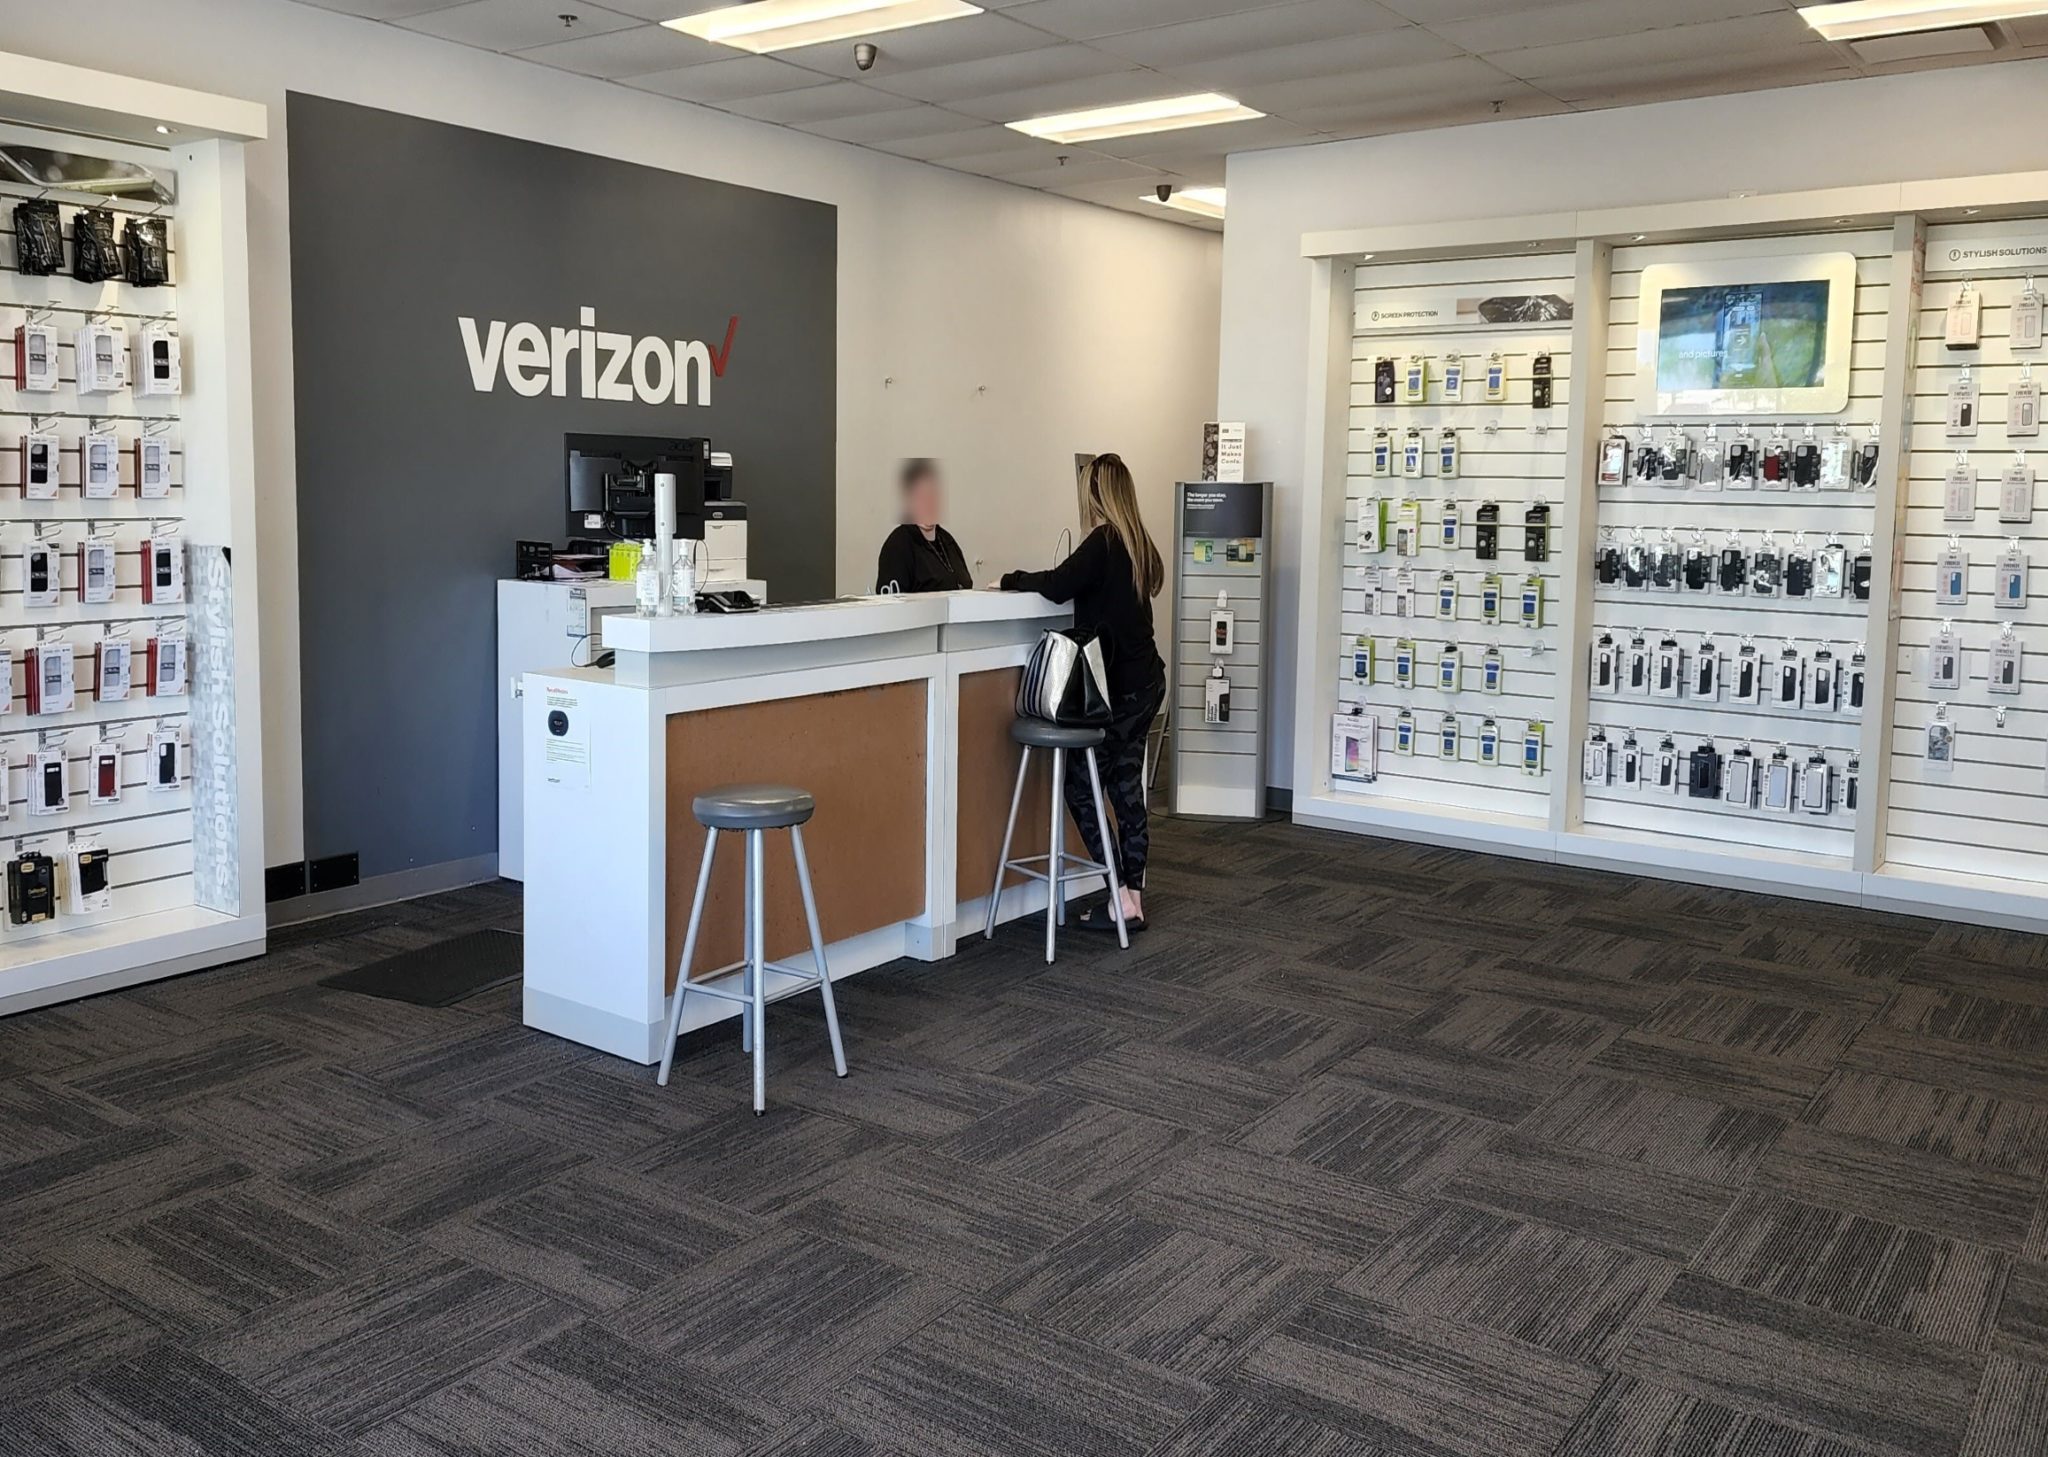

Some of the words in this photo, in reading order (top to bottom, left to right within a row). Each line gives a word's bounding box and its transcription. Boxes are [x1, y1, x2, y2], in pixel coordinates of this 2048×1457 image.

[1962, 249, 1998, 258] STYLISH
[1999, 246, 2048, 256] SOLUTIONS
[1403, 310, 1439, 318] PROTECTION
[457, 305, 711, 407] verizon
[1679, 351, 1694, 359] and
[1695, 349, 1728, 360] pictures
[205, 557, 227, 696] Stylish
[211, 700, 231, 893] Solutions.
